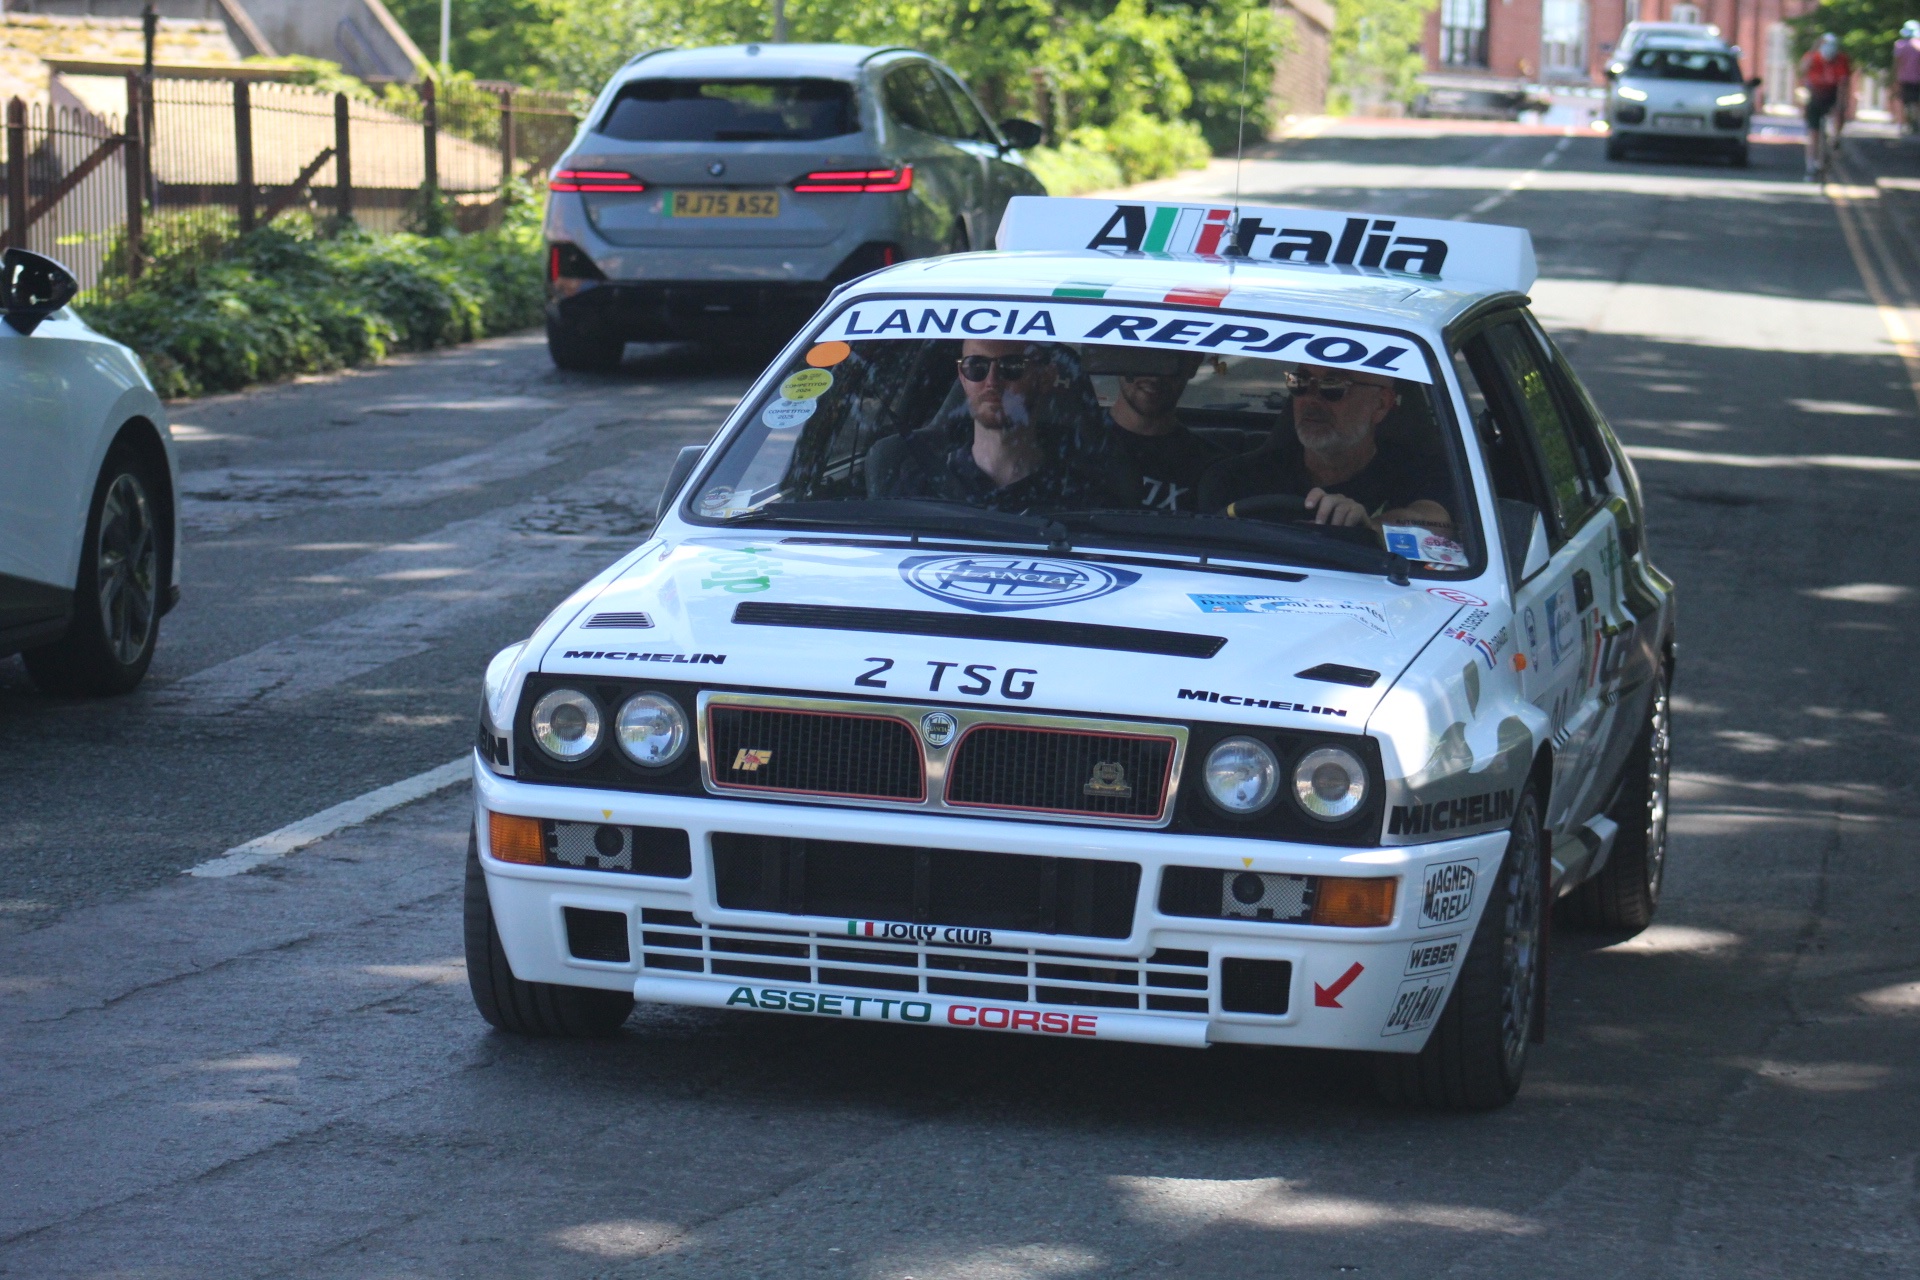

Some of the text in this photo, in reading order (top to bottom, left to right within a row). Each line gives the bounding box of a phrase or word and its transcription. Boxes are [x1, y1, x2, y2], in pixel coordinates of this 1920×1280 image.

[676, 194, 774, 214] RJ75 ASZ
[1086, 204, 1449, 276] Alitalia
[844, 308, 1409, 371] LANCIA REPSOL
[785, 381, 828, 389] COMPETITOR
[961, 569, 1067, 585] LANCIA
[563, 650, 727, 665] MICHELIN
[854, 657, 1038, 700] 2 TSG
[1177, 688, 1347, 717] MICHELIN
[732, 749, 772, 771] HF
[1387, 789, 1515, 835] MICHELIN
[882, 923, 992, 945] JOLLY CLUB
[1409, 942, 1457, 969] WEBER
[726, 986, 1098, 1037] ASSETTO CORSE
